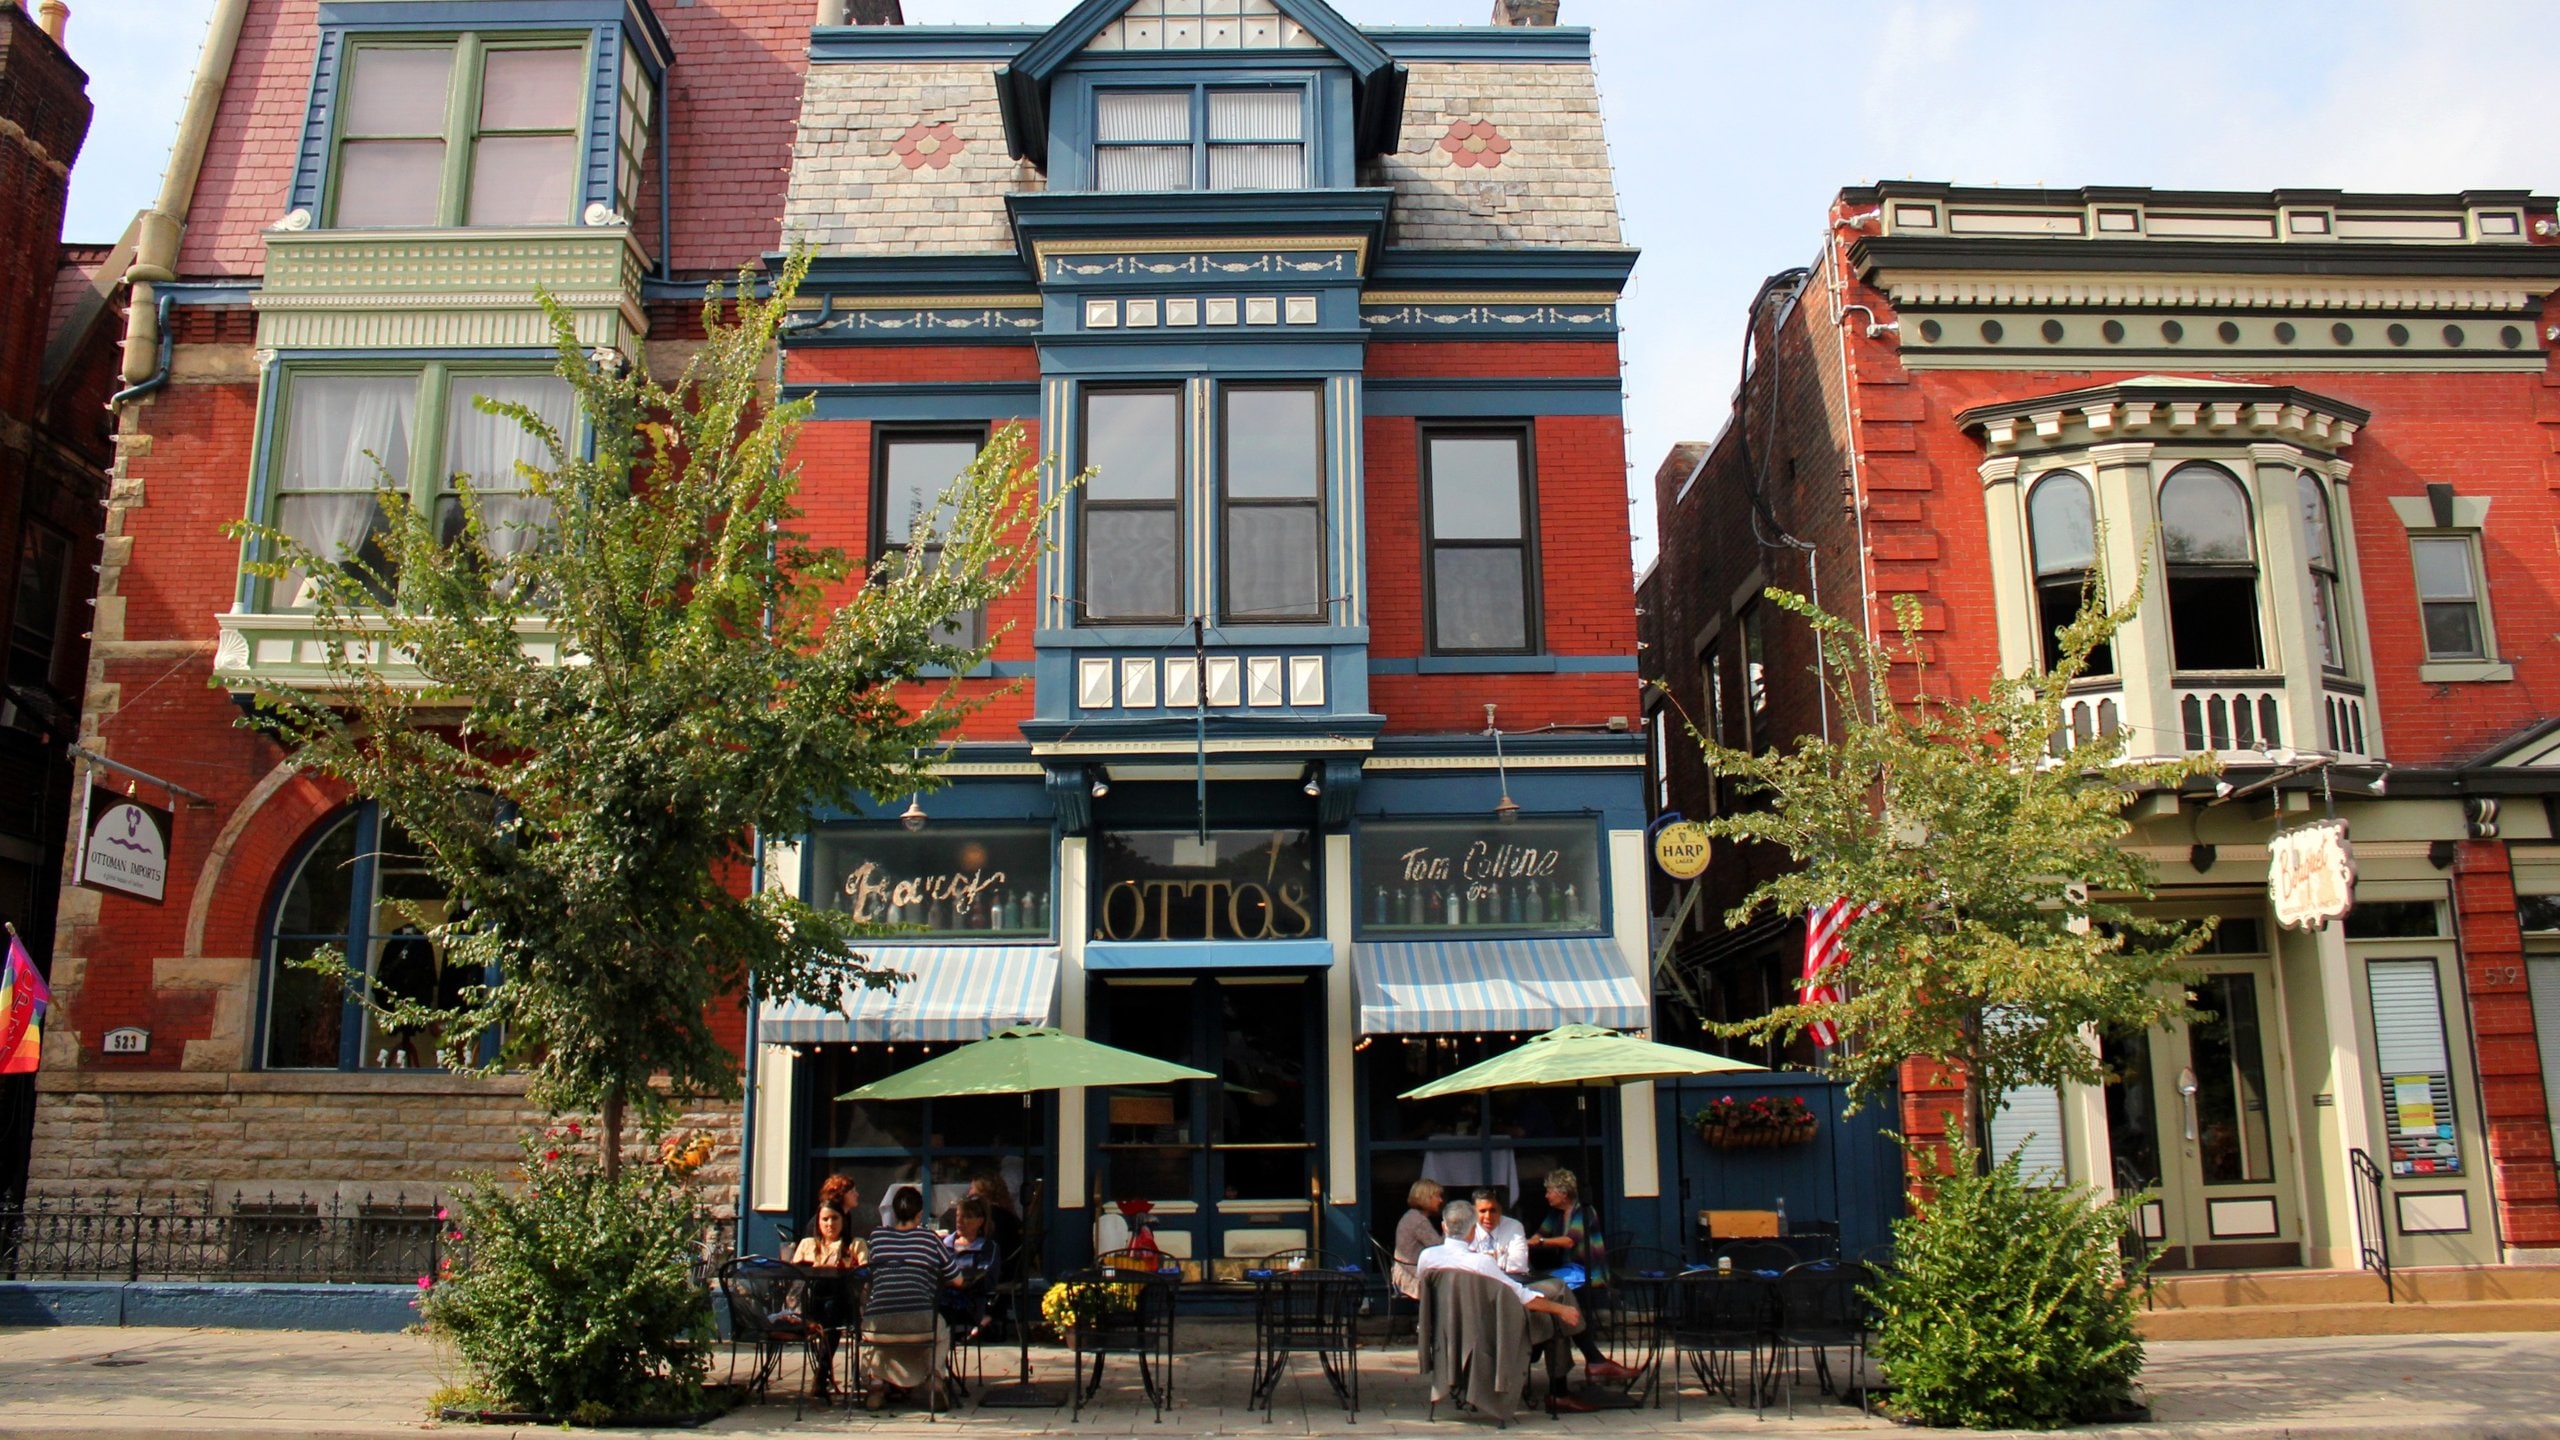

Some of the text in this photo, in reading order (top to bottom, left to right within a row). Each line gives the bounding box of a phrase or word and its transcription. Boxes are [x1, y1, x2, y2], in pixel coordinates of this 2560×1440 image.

[1663, 844, 1704, 858] HARP
[91, 851, 127, 872] OTTOMAN
[131, 862, 161, 882] IMPORTS
[1401, 848, 1450, 881] Tom
[114, 1034, 137, 1050] 523
